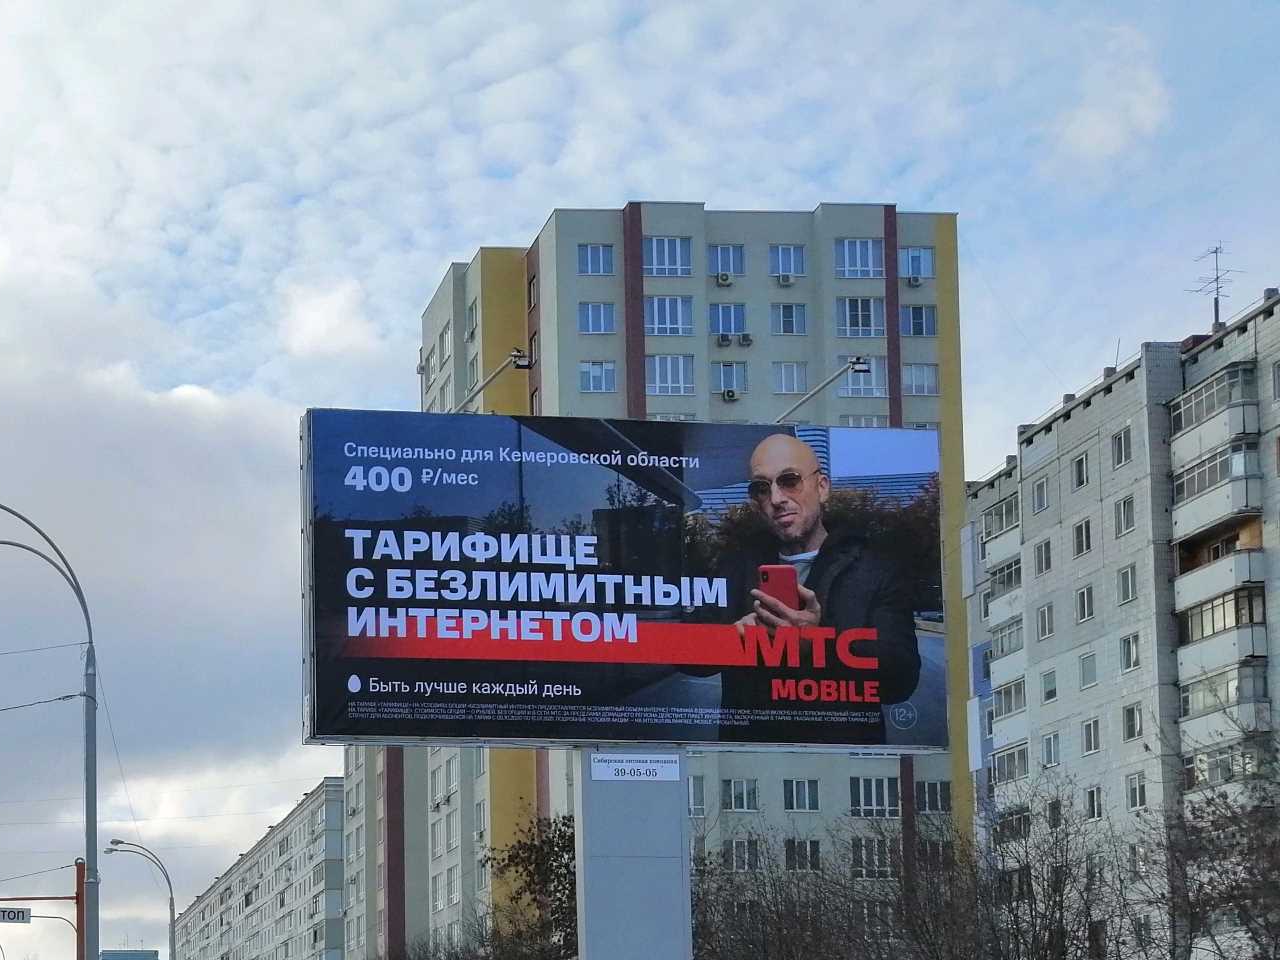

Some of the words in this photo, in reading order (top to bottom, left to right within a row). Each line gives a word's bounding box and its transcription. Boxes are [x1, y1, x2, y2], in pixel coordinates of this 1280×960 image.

[343, 441, 457, 463] Специально
[460, 449, 494, 464] для
[498, 447, 622, 468] Кемеровской
[626, 452, 701, 469] области
[343, 464, 413, 492] 400
[344, 528, 599, 571] ТАРИФИЩЕ
[345, 567, 375, 599] С
[386, 568, 728, 608] БЕЗЛИМИТНЫМ
[346, 606, 638, 643] ИНТЕРНЕТОМ
[746, 626, 880, 670] МТС
[369, 677, 410, 693] Быть
[413, 680, 468, 696] лучше
[471, 679, 538, 697] каждый
[542, 682, 582, 697] день
[771, 679, 881, 703] MOBILE
[892, 707, 914, 722] 12+
[613, 767, 658, 778] 39-05-05
